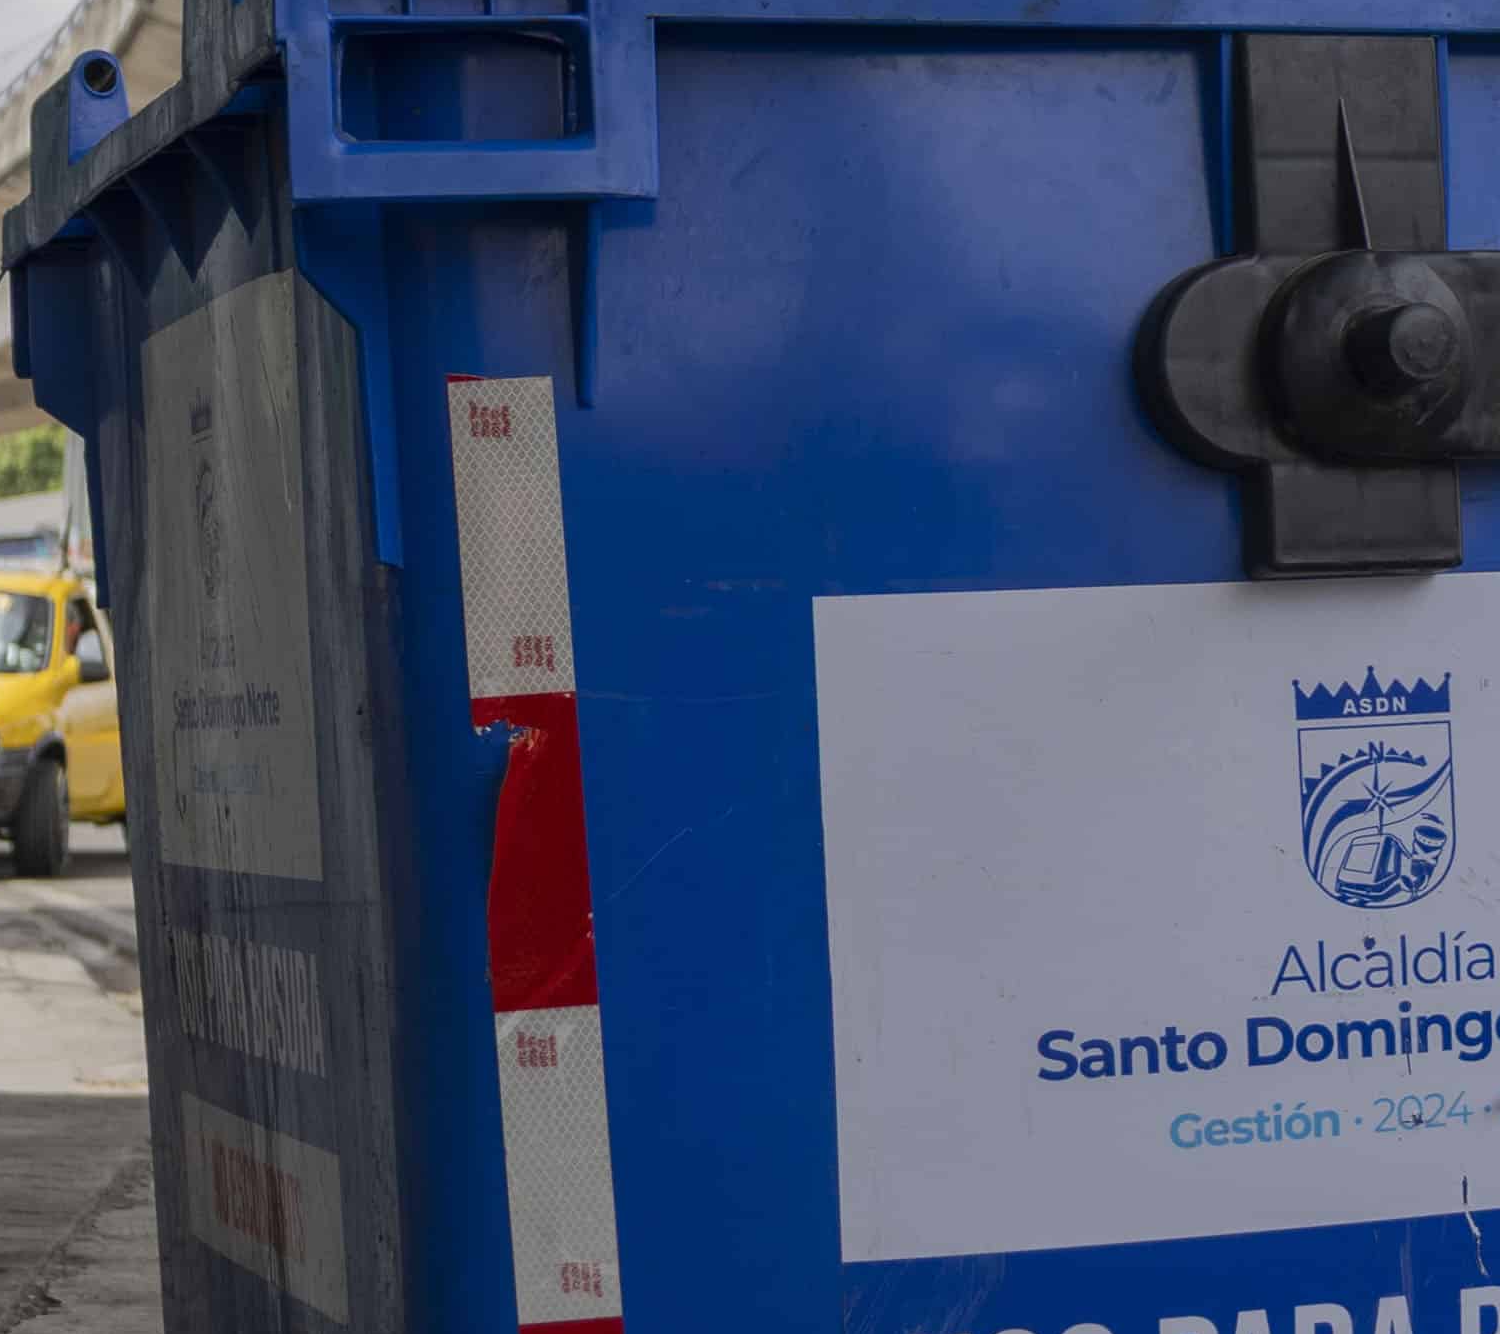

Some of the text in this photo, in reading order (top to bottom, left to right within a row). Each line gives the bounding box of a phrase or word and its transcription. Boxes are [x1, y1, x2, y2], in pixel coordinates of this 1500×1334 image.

[1342, 696, 1408, 715] ASDN
[1270, 930, 1496, 996] Alcaldía
[246, 941, 326, 1079] BASURA
[1037, 1026, 1228, 1081] Santo
[1169, 1101, 1341, 1149] Gestión
[1372, 1090, 1476, 1133] 2024
